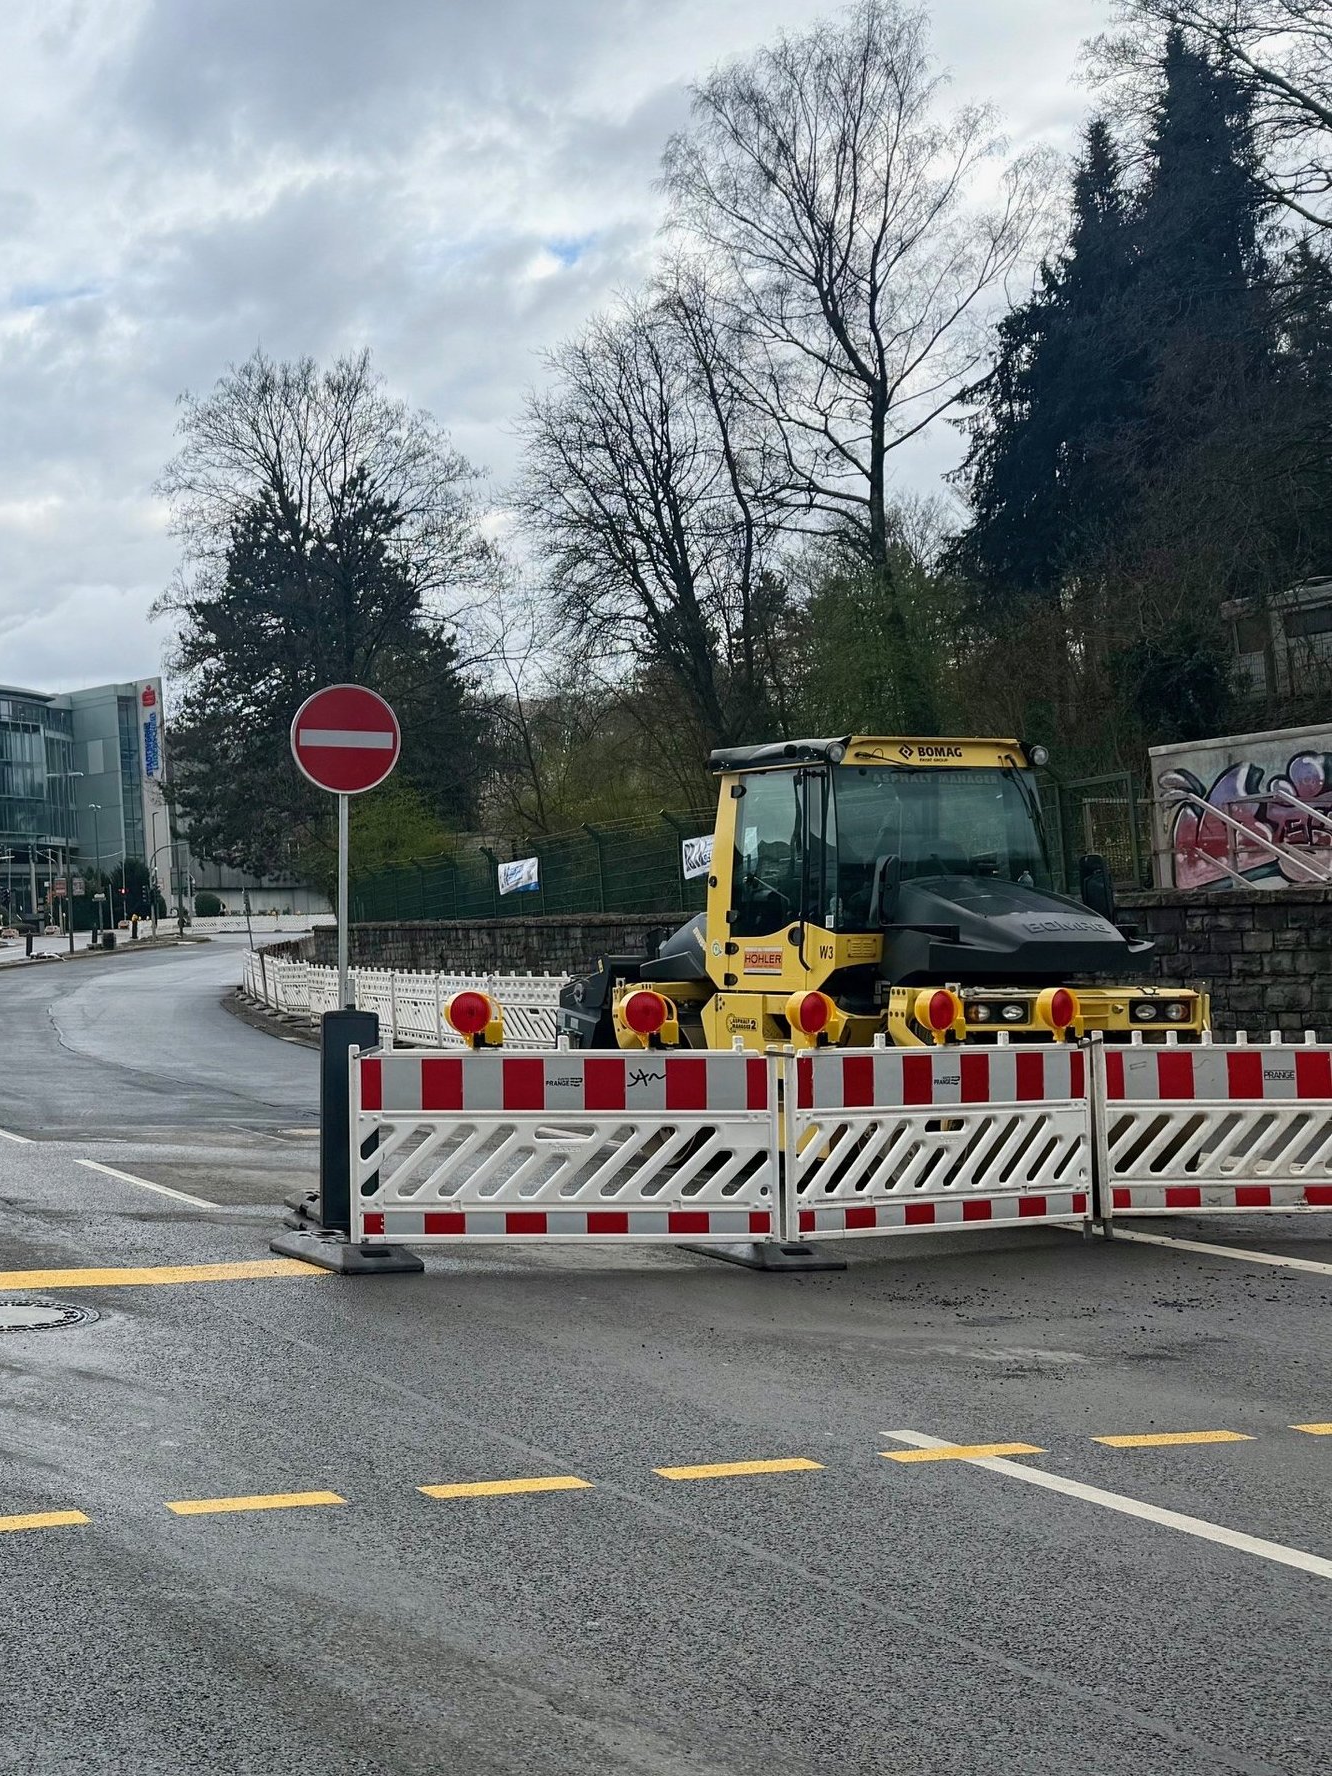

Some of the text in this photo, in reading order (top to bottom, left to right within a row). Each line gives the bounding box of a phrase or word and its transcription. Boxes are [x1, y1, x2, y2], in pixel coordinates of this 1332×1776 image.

[918, 746, 963, 758] BOMAG
[872, 773, 998, 784] ASPHALT MANAGER
[1023, 920, 1112, 934] BOMAG
[819, 945, 834, 960] W3
[751, 1019, 757, 1030] 2
[1264, 1071, 1295, 1080] PRANGE
